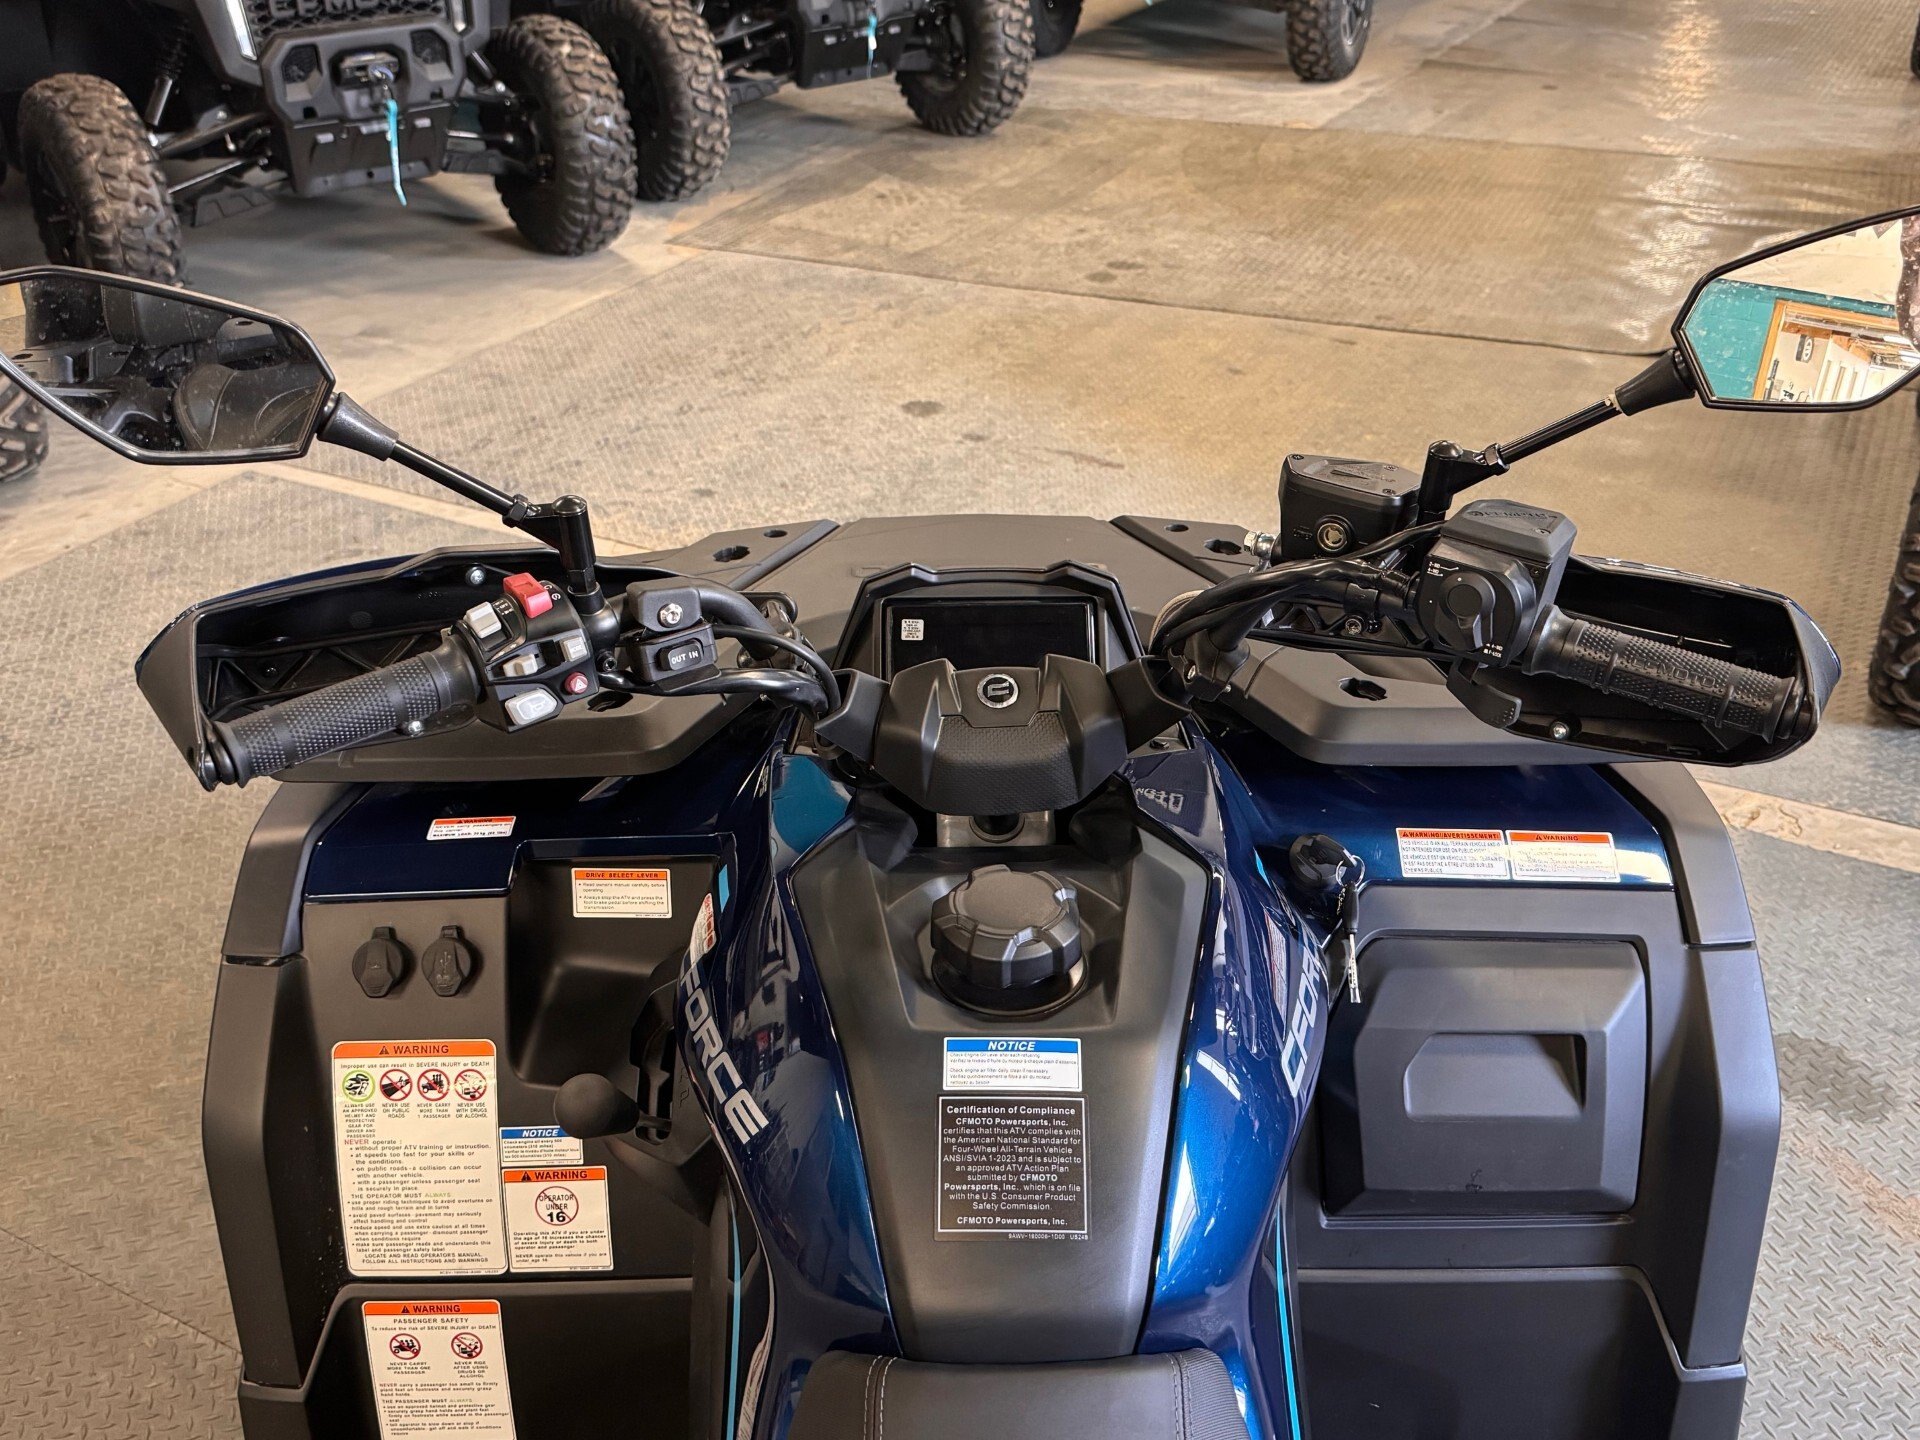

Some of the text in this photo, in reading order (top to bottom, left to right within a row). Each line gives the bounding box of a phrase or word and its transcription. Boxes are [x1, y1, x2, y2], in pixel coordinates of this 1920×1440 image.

[671, 650, 699, 665] OUT IN
[393, 1045, 450, 1054] WARNING
[987, 1041, 1036, 1051] NOTICE
[947, 1106, 1076, 1115] Certification of Compliance
[955, 1117, 993, 1125] CFMOTO
[952, 1145, 999, 1153] Four-Wheel
[943, 1154, 987, 1162] ANSI/SVIA
[534, 1171, 588, 1179] WARNING
[1069, 1184, 1081, 1192] file
[1045, 1193, 1076, 1201] Product
[973, 1202, 998, 1210] Safety
[547, 1212, 566, 1222] 16
[957, 1216, 993, 1224] CFMOTO
[413, 1305, 461, 1313] WARNING
